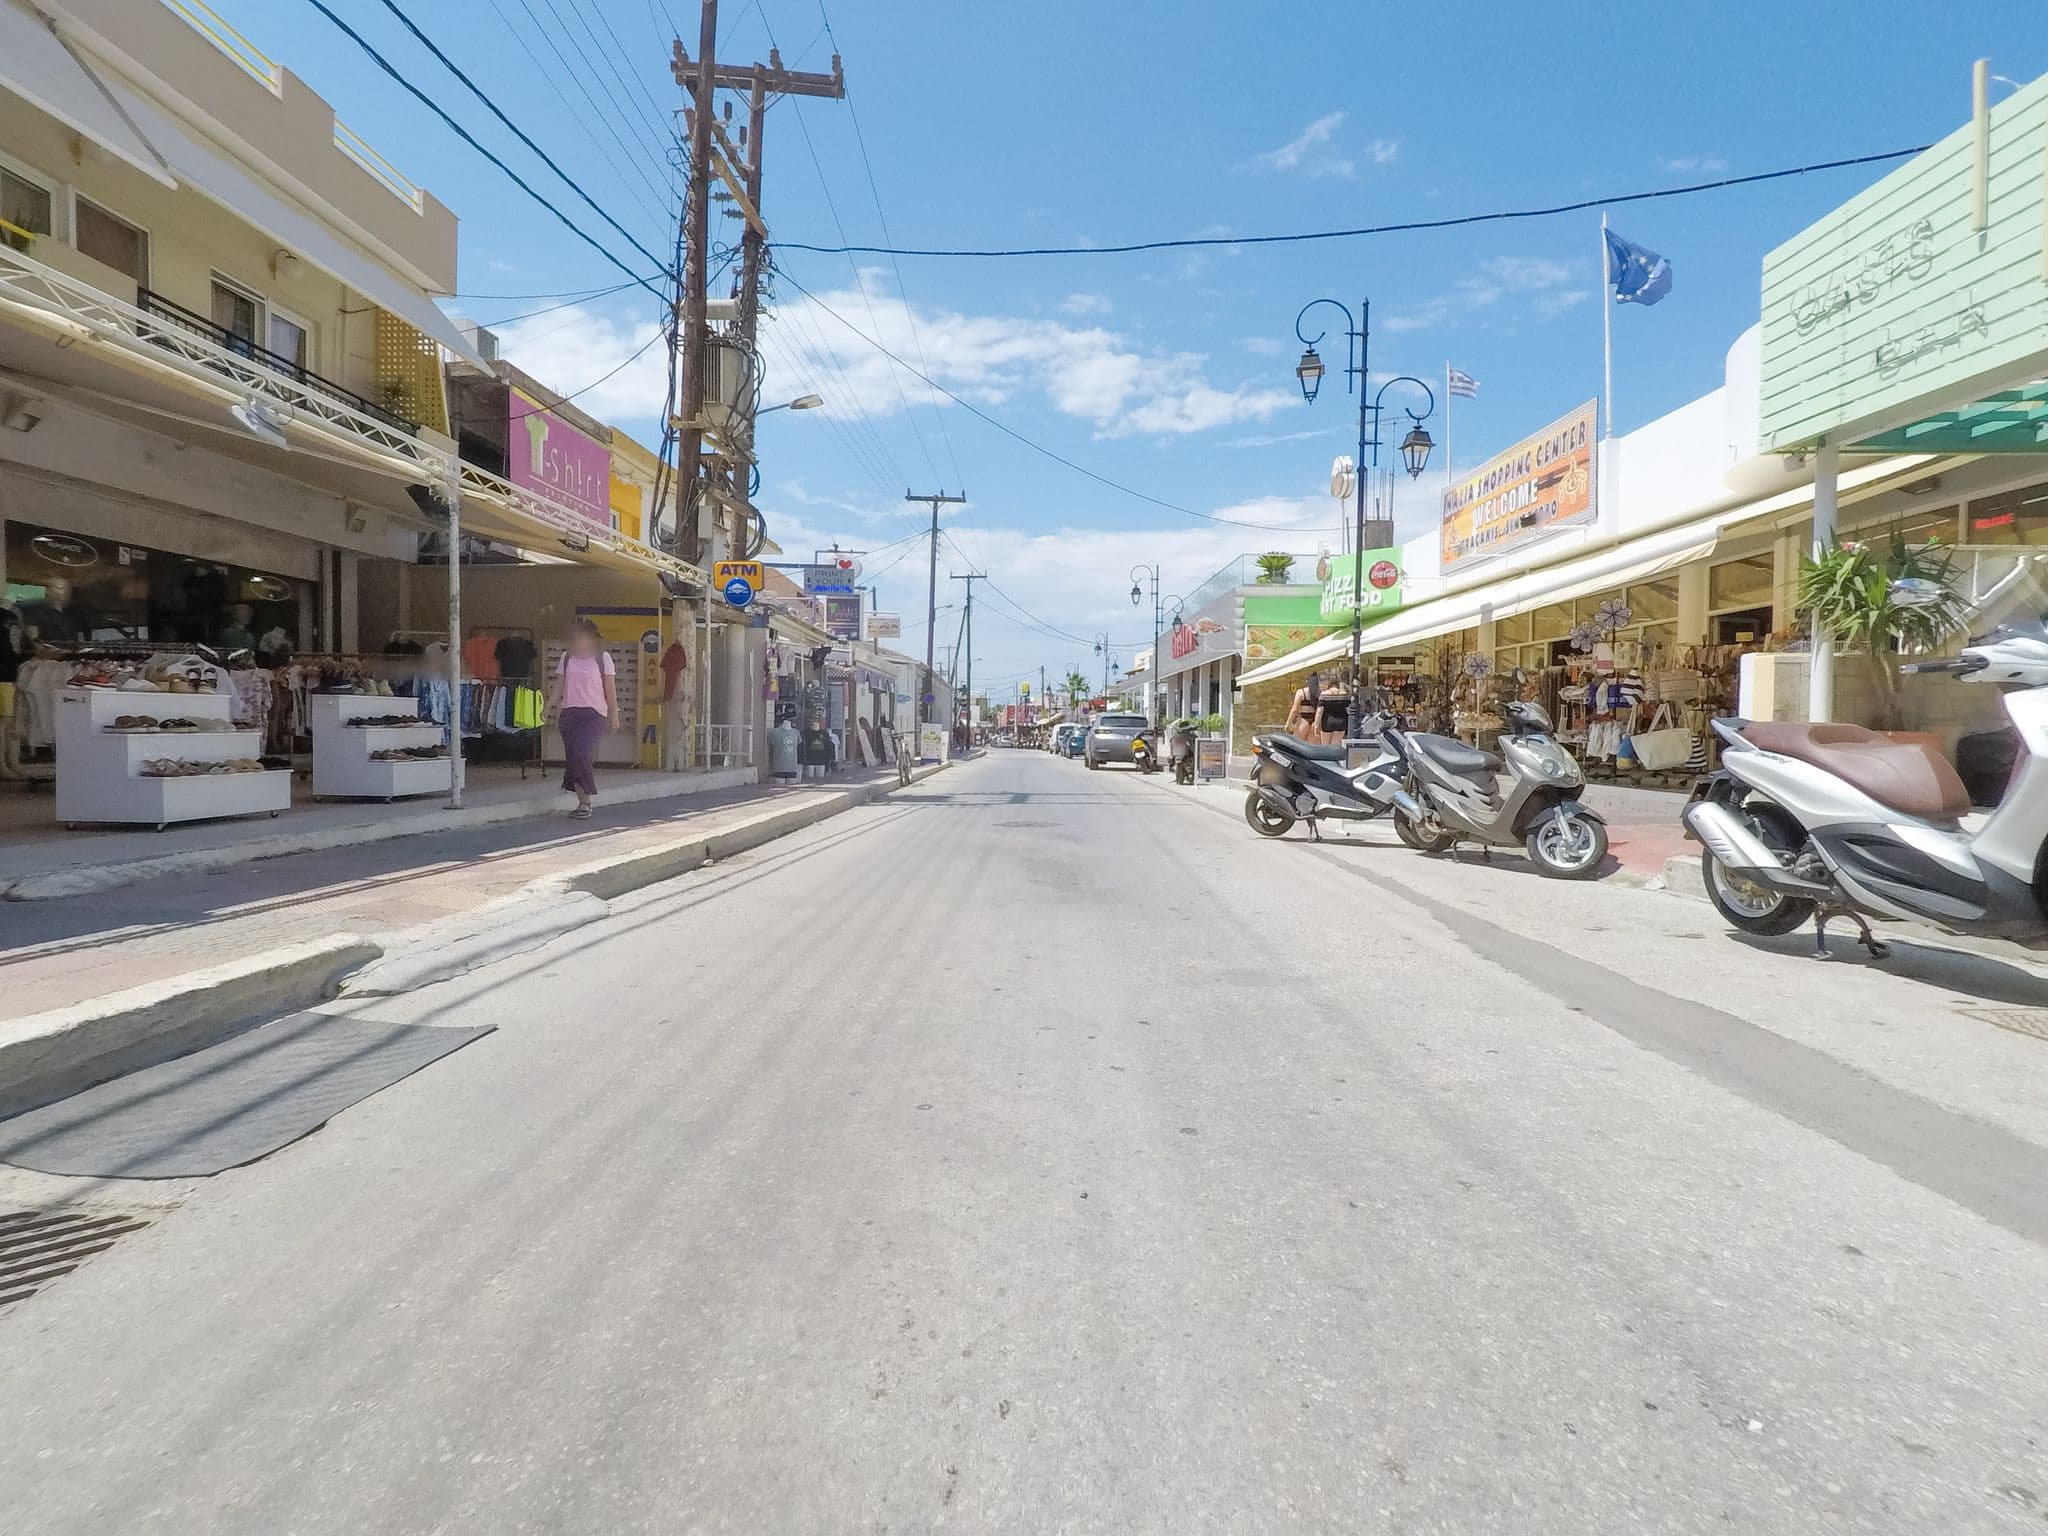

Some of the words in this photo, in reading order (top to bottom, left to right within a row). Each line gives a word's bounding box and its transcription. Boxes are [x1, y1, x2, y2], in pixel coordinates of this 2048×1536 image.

[1443, 484, 1474, 513] MALIA
[1477, 450, 1533, 499] SHOPPING
[1536, 420, 1587, 467] CENTER
[1472, 478, 1540, 529] WELCOME
[720, 564, 758, 576] ATM
[814, 570, 844, 578] PRINT
[815, 578, 844, 586] YOUR
[1325, 575, 1366, 597] PIZZ
[1340, 591, 1383, 610] FOOD
